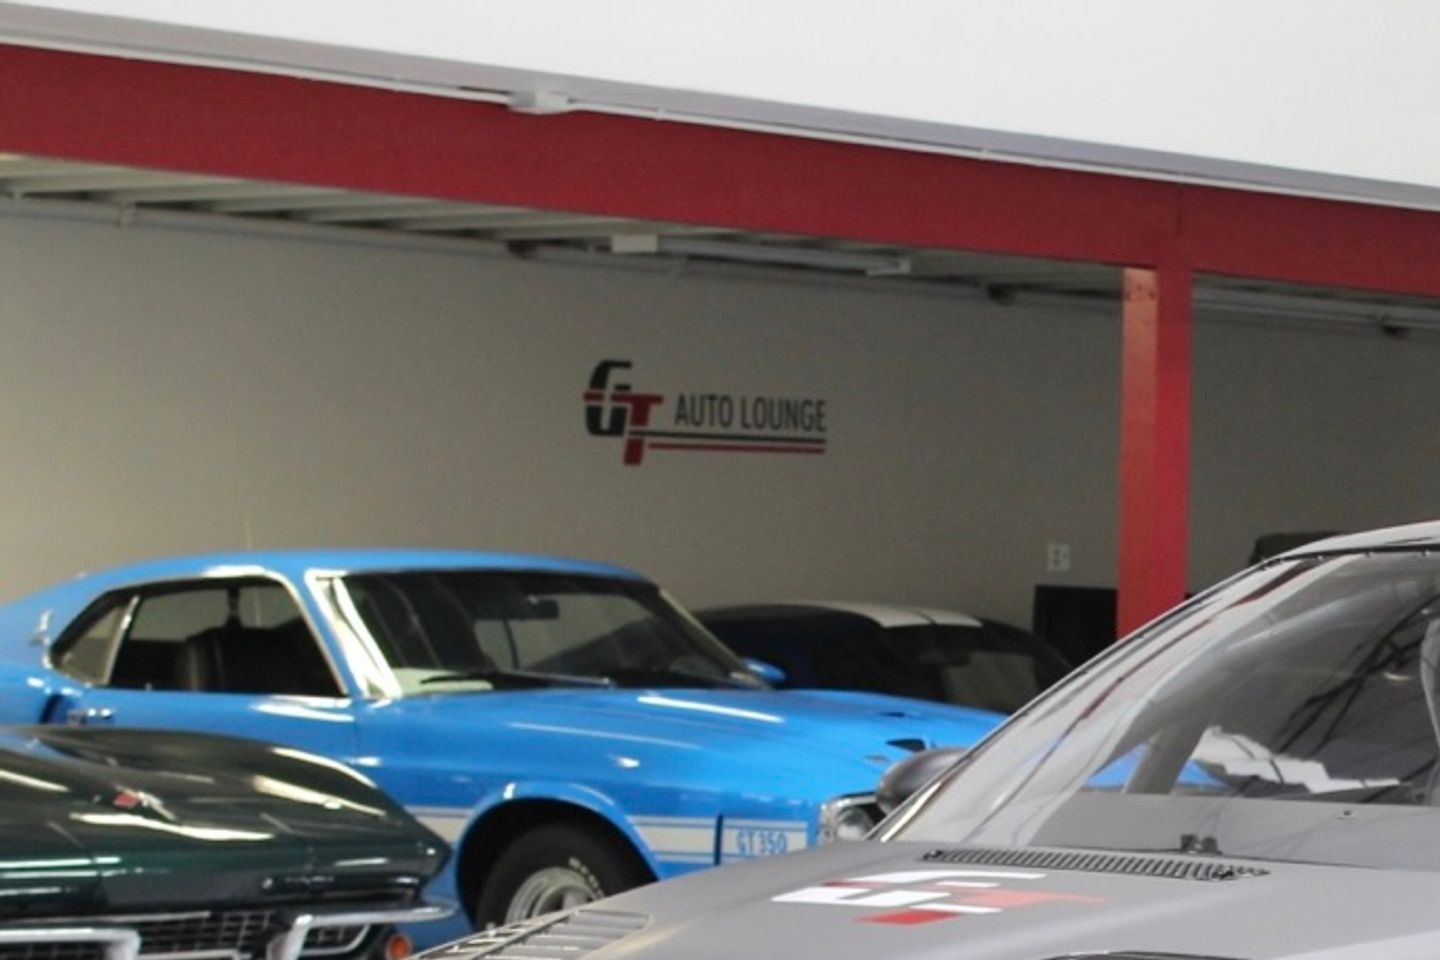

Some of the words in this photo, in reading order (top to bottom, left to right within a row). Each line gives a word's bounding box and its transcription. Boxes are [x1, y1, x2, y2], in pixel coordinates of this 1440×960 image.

[583, 360, 663, 466] GT
[675, 394, 734, 426] AUTO
[740, 397, 827, 432] LOUNGE
[737, 829, 754, 856] GT
[759, 831, 786, 854] 350
